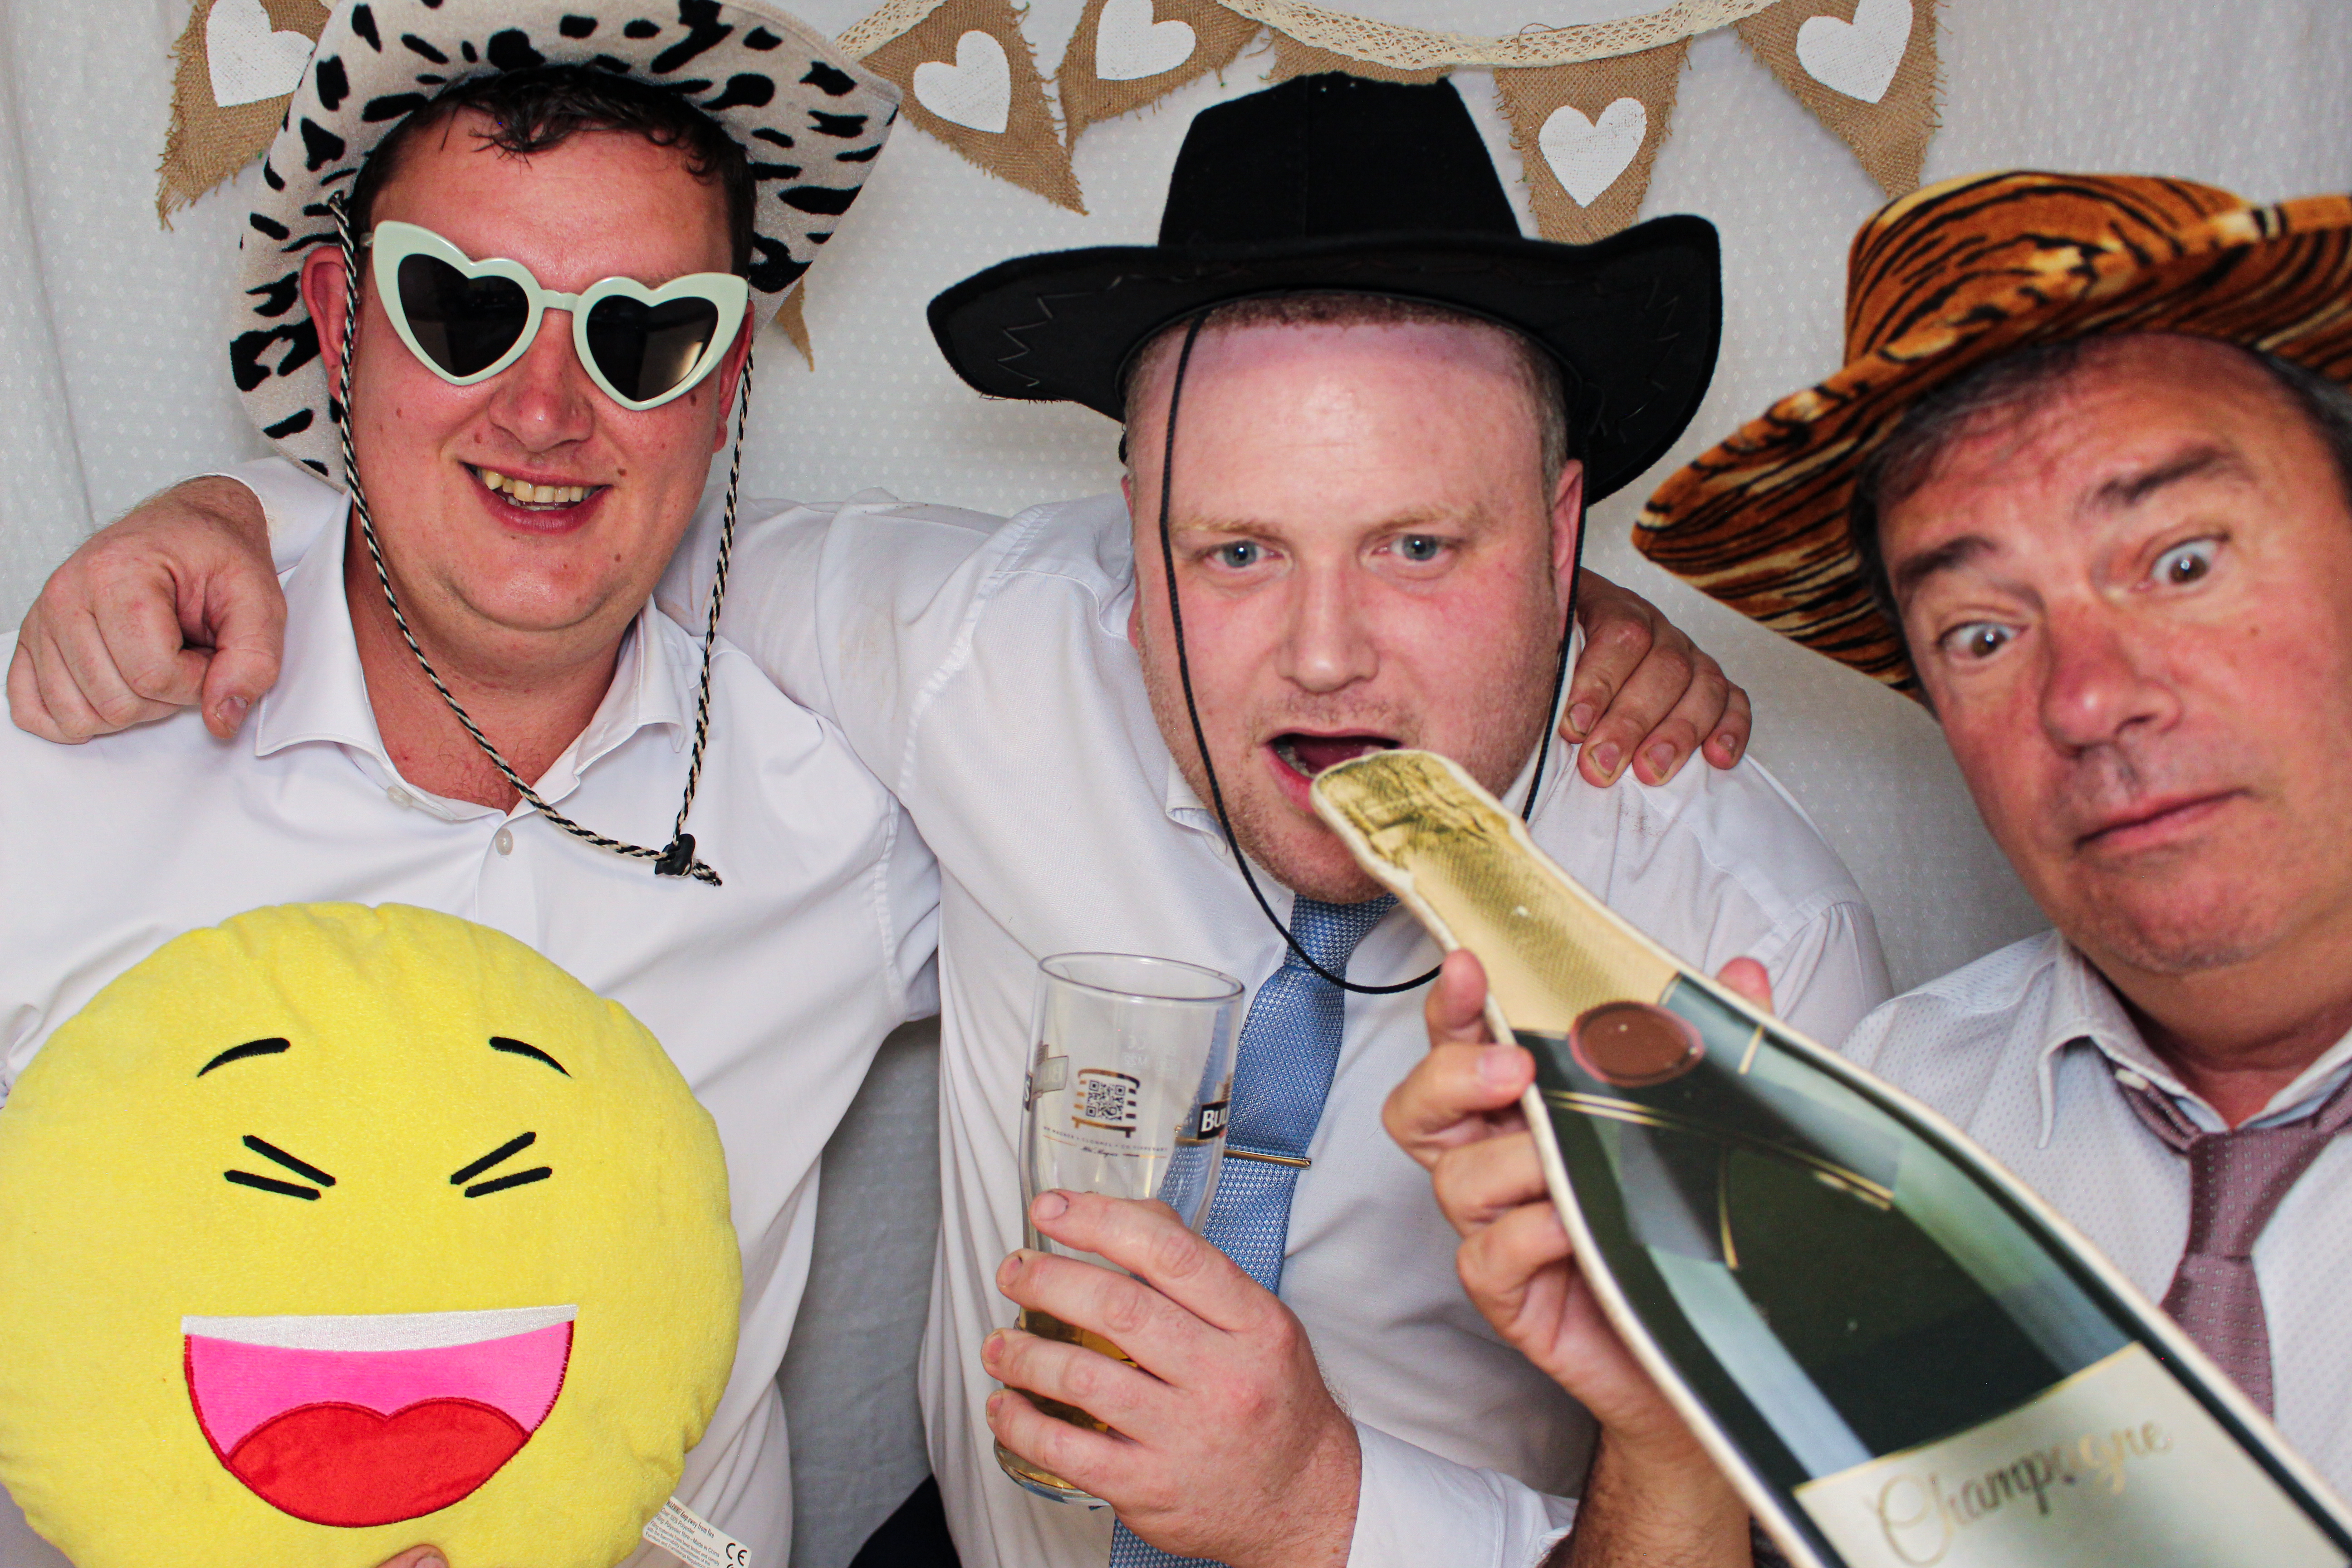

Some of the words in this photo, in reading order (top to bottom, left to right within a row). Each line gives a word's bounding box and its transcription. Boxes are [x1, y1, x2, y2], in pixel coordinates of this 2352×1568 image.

[1864, 1419, 2174, 1568] Champagne
[666, 1499, 683, 1515] WARNING!
[680, 1510, 689, 1521] Keep
[687, 1518, 698, 1529] away
[697, 1522, 708, 1533] from
[678, 1520, 695, 1534] Polyester
[665, 1520, 681, 1534] Polyester
[693, 1538, 704, 1548] Made
[707, 1547, 720, 1557] China
